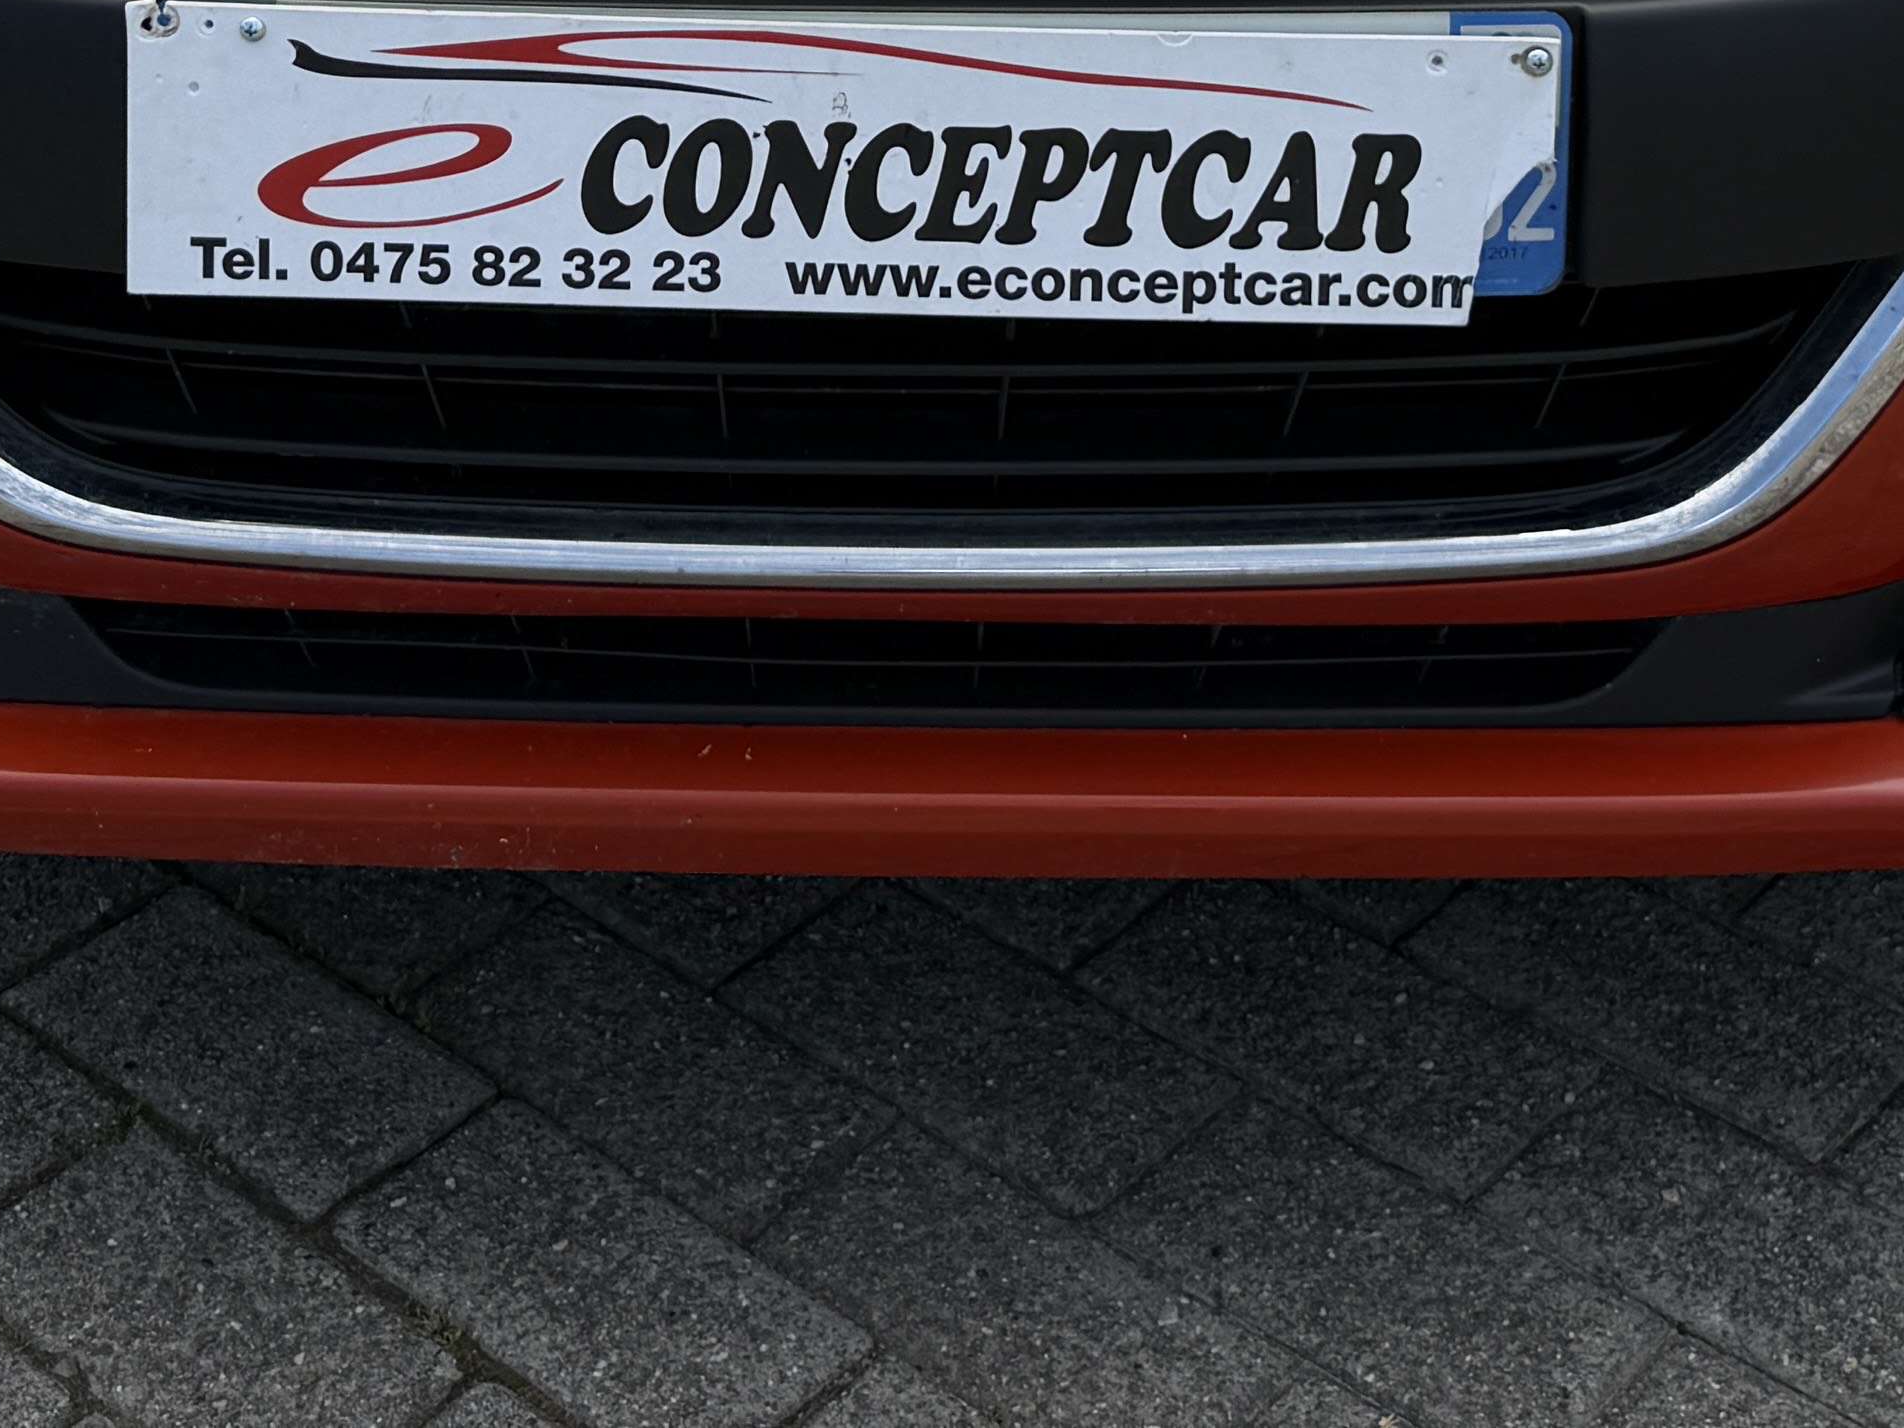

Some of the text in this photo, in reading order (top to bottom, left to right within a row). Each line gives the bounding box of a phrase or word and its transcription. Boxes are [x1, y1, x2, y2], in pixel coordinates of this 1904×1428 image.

[580, 114, 1421, 254] CONCEPTCAR
[191, 236, 1475, 313] Tel. 0475 82 32 23 www.econceptcar.com
